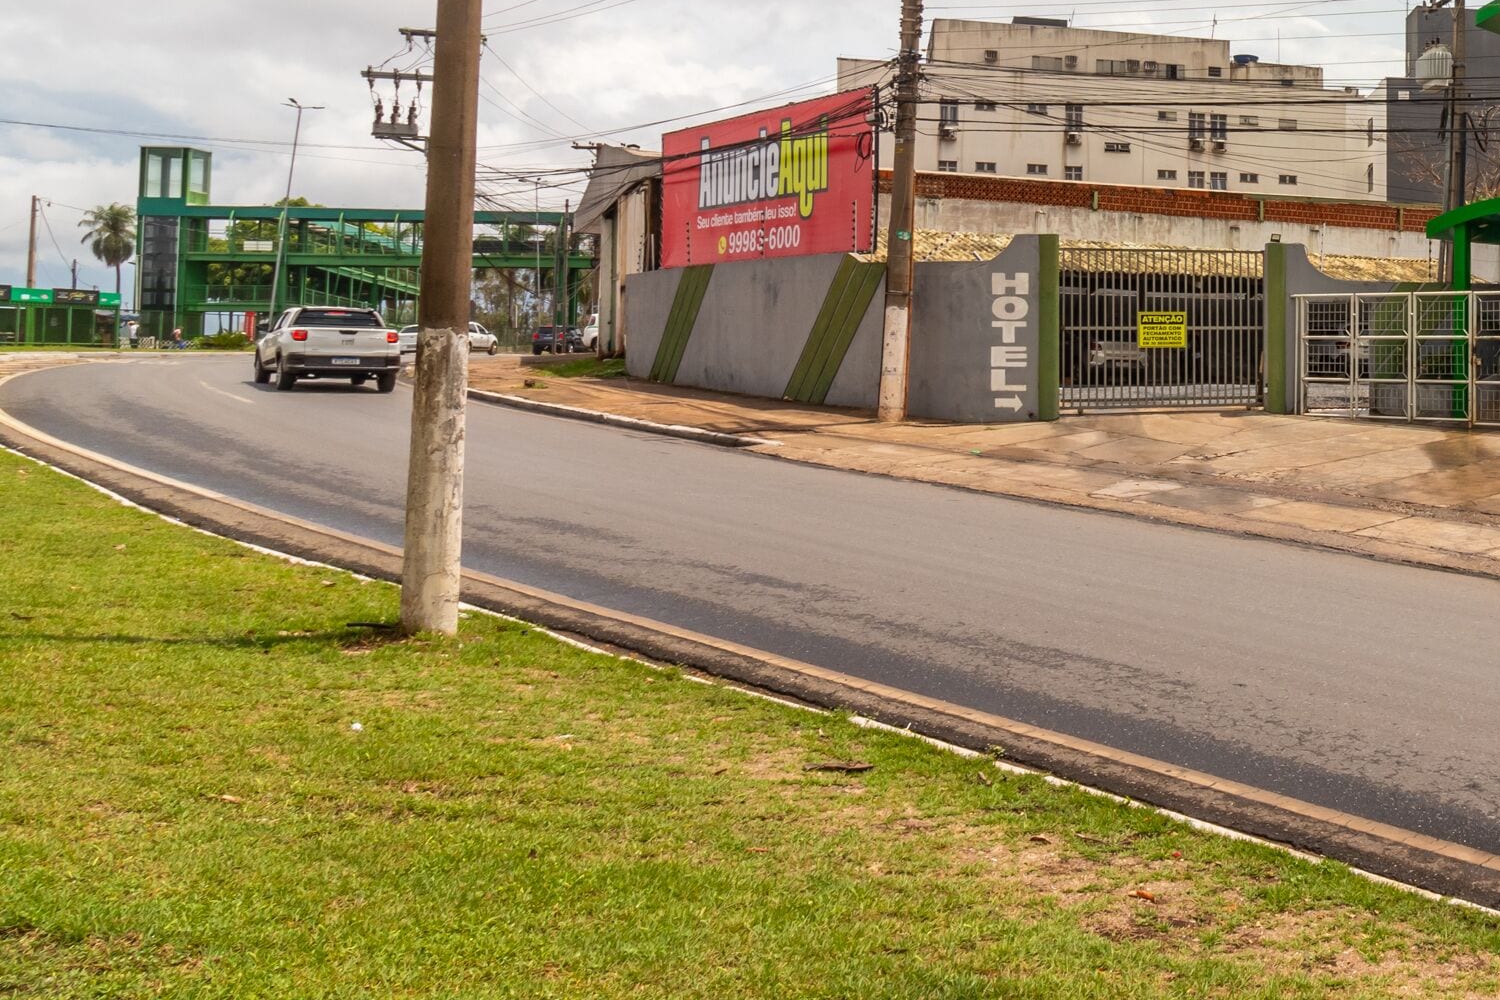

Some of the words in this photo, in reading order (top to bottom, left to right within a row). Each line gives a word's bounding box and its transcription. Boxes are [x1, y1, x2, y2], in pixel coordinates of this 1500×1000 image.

[697, 216, 710, 229] Seu
[710, 212, 734, 226] cliente
[734, 208, 764, 224] também
[765, 205, 777, 220] leu
[778, 202, 797, 218] isso!
[991, 272, 1029, 391] HOTEL
[1142, 315, 1183, 323] ATENÇÃO
